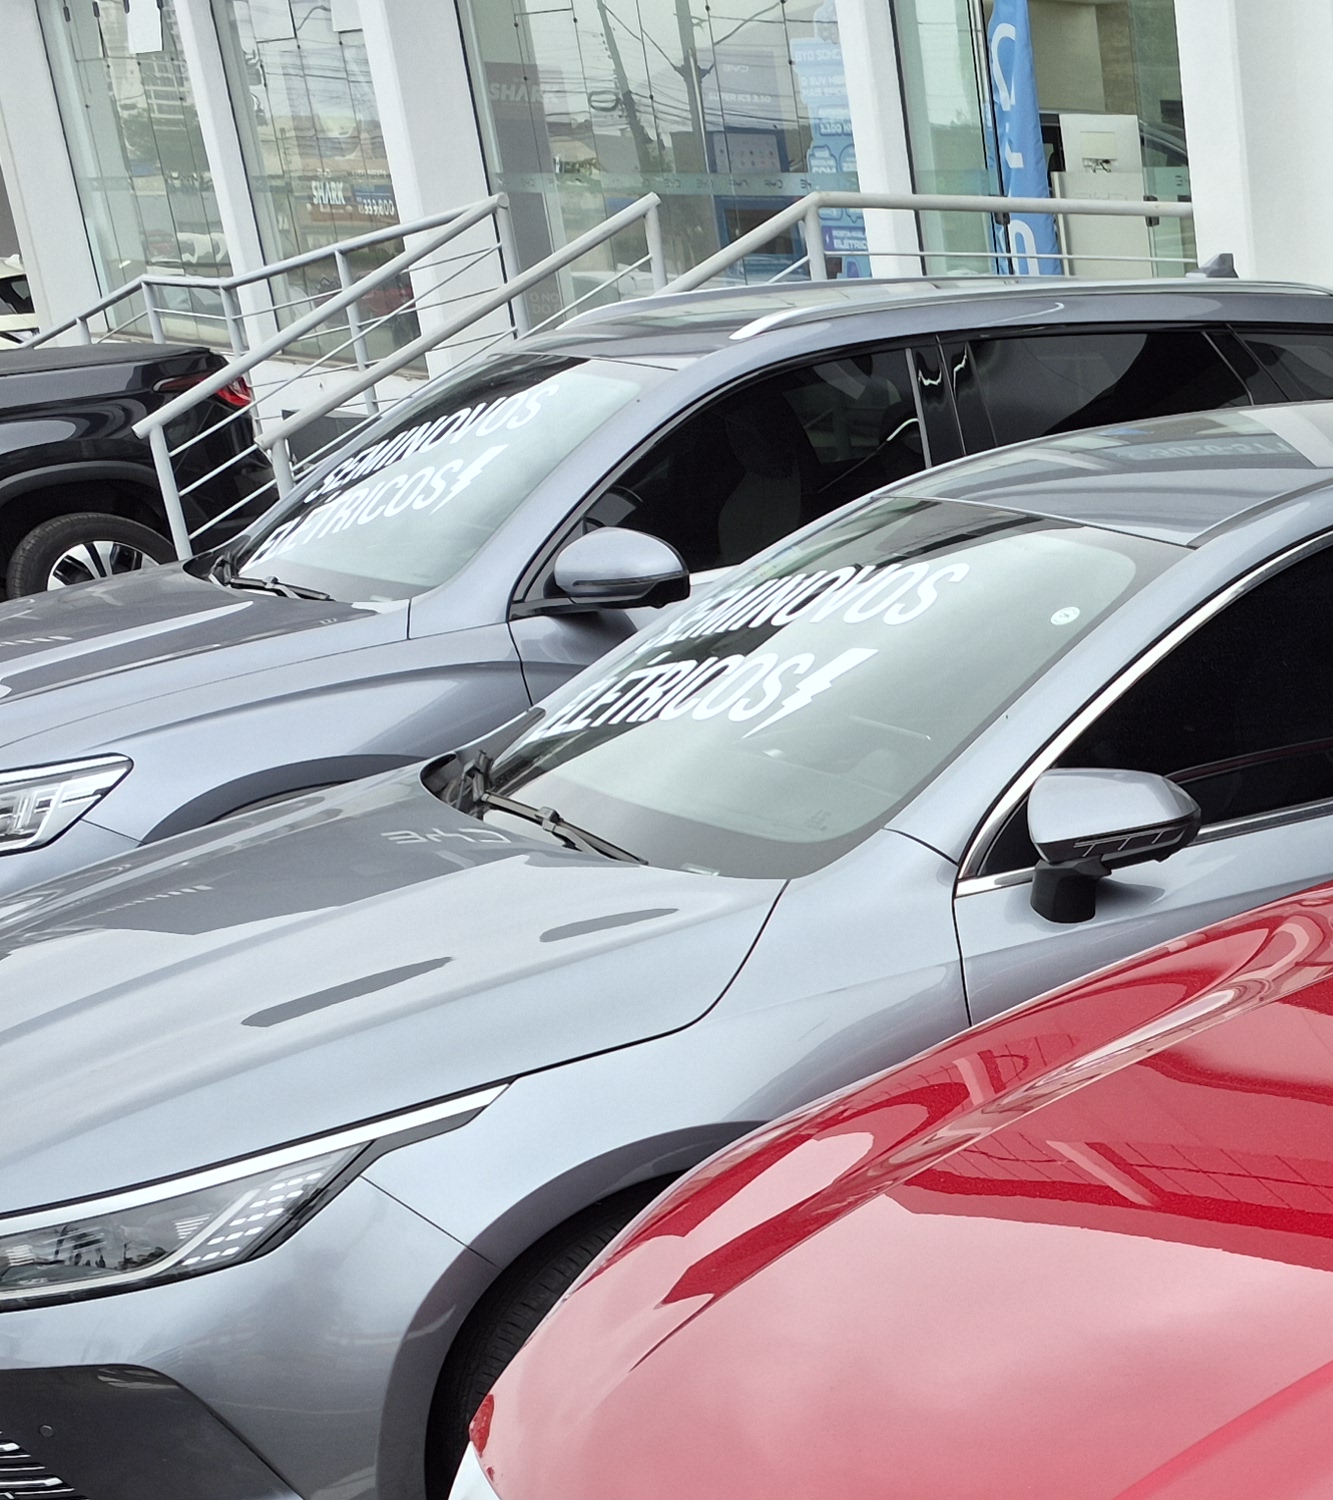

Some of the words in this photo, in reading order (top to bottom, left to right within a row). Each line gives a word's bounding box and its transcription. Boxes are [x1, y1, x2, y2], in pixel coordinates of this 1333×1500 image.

[311, 181, 346, 206] SHARK
[304, 383, 559, 504] SEMINOVOS
[238, 458, 463, 573] ELÉTRICOS
[636, 561, 970, 657] SEMINOVOS
[522, 651, 803, 747] ELÉTRICOS
